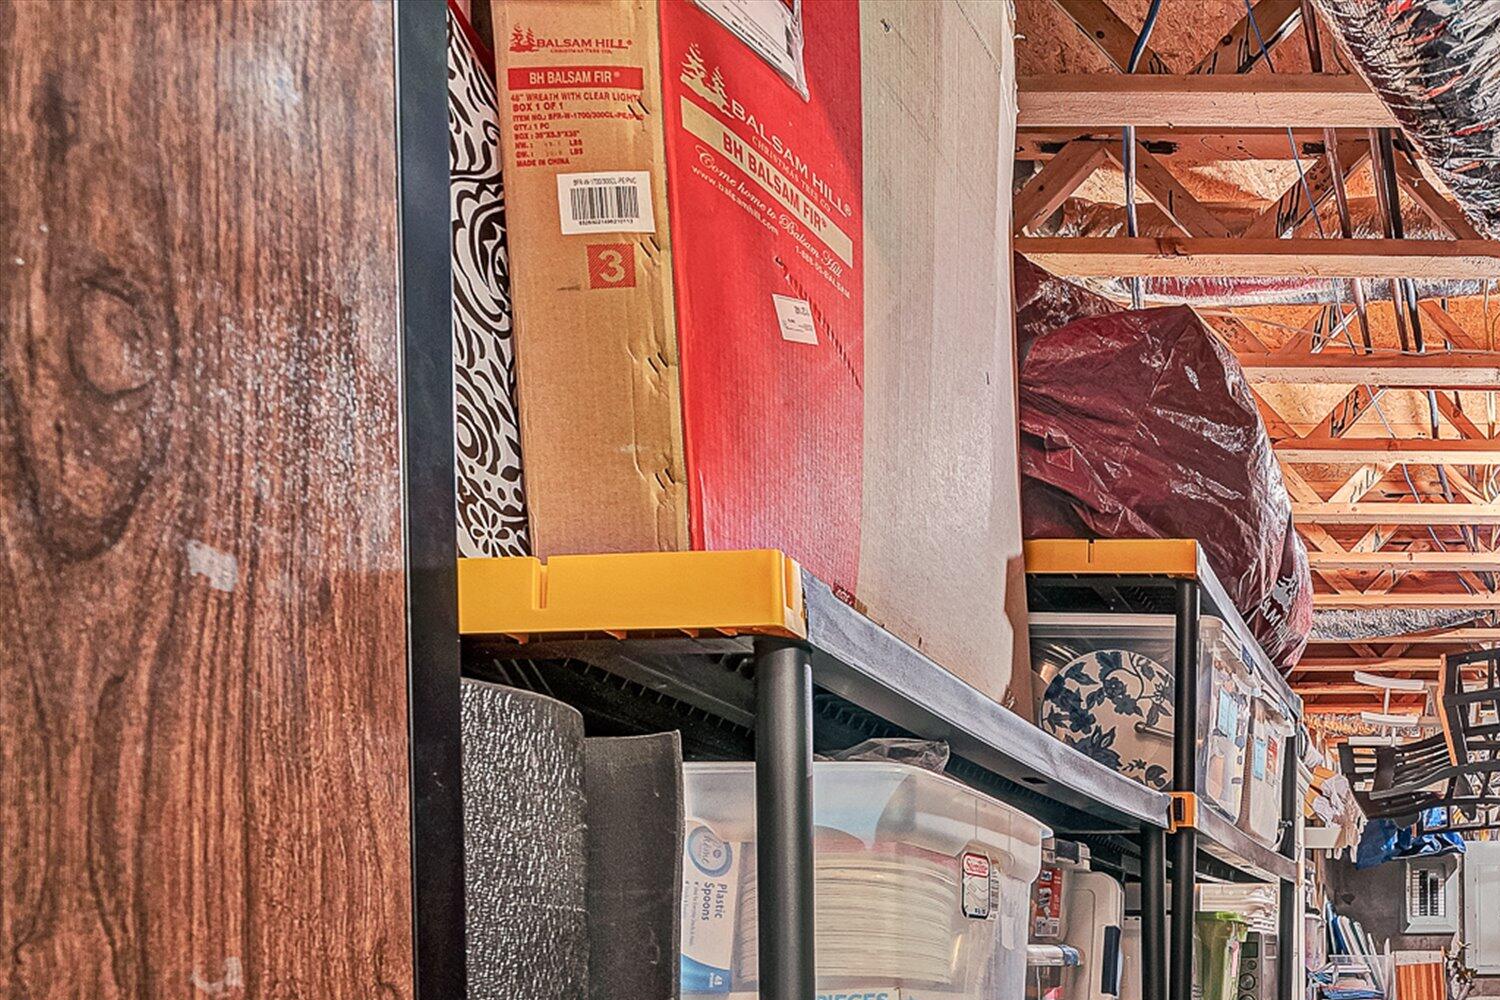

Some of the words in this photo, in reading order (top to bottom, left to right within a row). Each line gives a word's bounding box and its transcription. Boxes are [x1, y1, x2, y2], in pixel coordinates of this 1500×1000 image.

[536, 39, 592, 48] BALSAM
[529, 72, 544, 84] BH
[547, 71, 590, 83] BALSAM
[513, 103, 532, 112] BOX
[544, 102, 555, 110] OF
[526, 92, 558, 101] WREATH
[561, 92, 580, 101] WITH
[584, 92, 610, 100] CLEAR
[732, 99, 808, 179] BALSAM
[695, 144, 736, 187] Come
[738, 182, 766, 211] home
[767, 206, 777, 219] to
[723, 132, 743, 163] BH
[748, 152, 800, 211] BALSAM
[599, 249, 626, 282] 3
[701, 882, 715, 921] Spoons
[715, 883, 728, 919] Plastic
